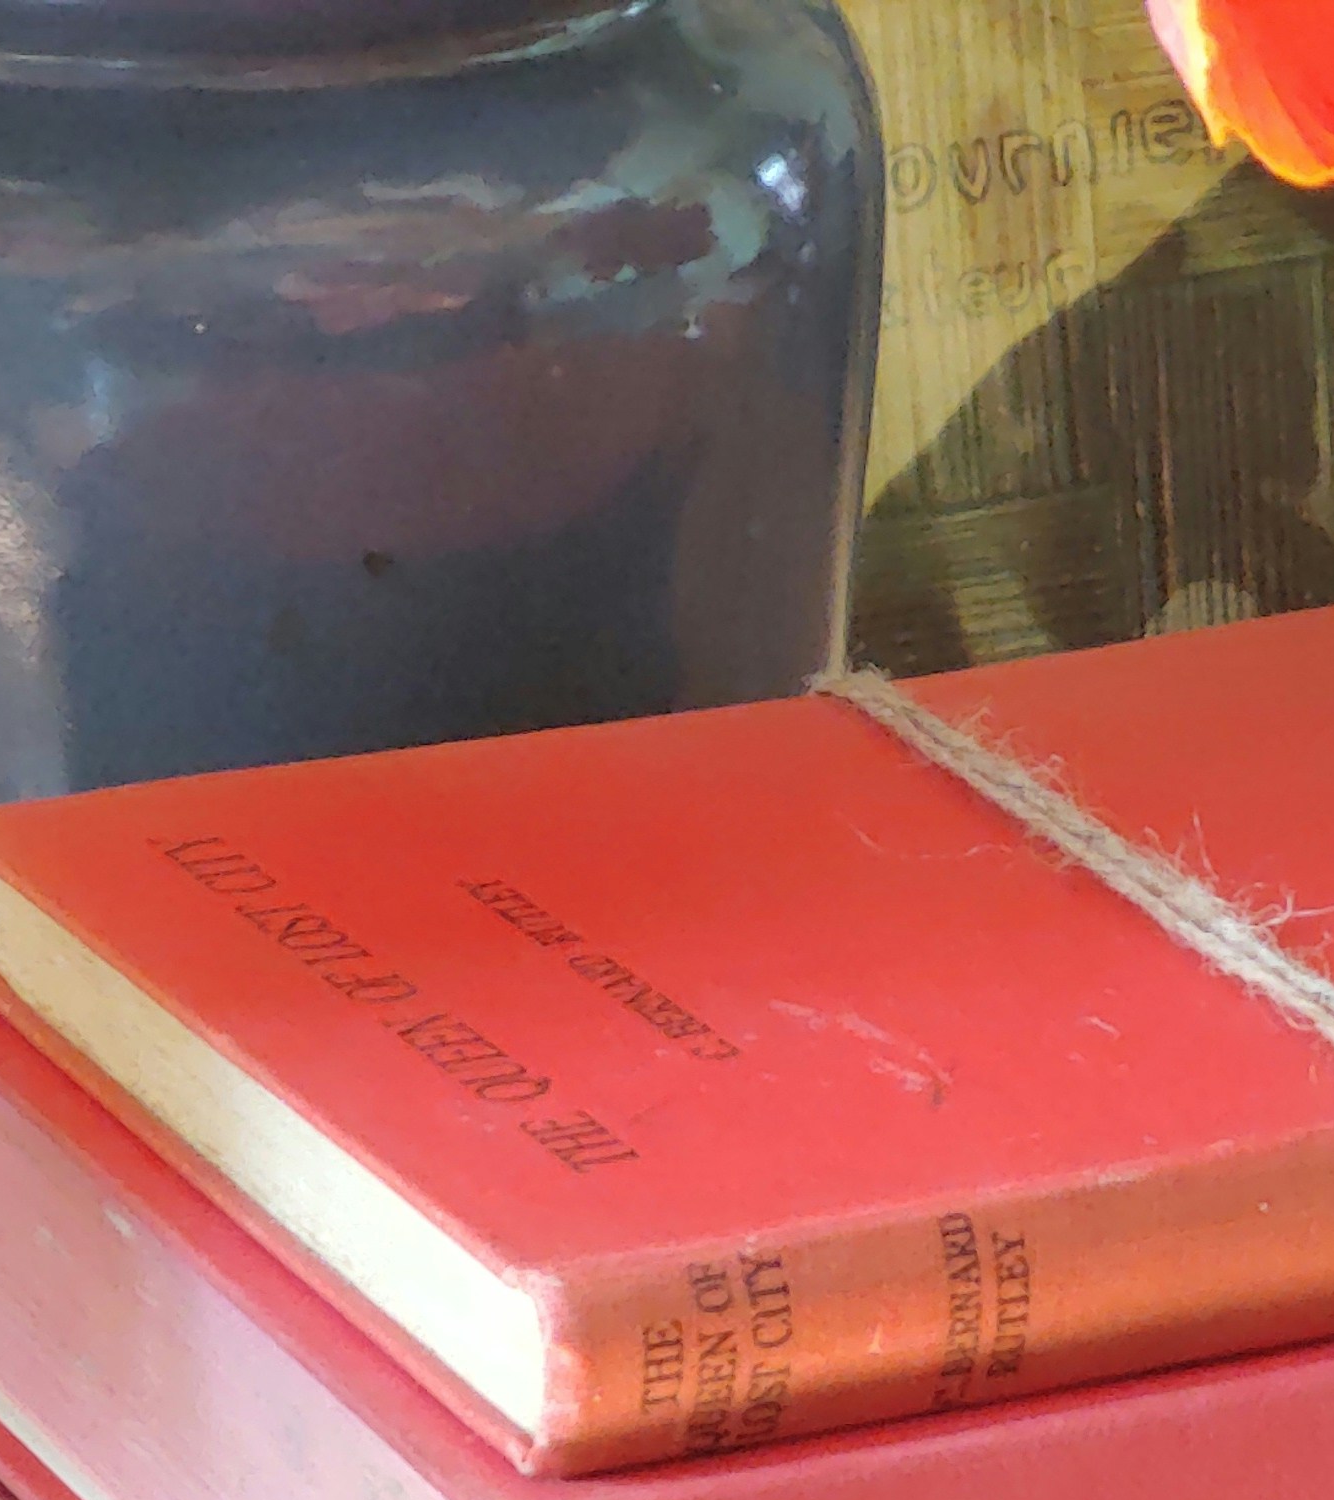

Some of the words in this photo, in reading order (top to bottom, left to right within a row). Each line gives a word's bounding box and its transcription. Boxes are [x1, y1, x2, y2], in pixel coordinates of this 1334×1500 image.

[148, 837, 277, 895] CITY
[235, 902, 373, 966] LOST
[326, 972, 416, 1007] OF
[382, 1012, 553, 1103] QUEEN
[520, 1110, 639, 1174] THE
[687, 1261, 735, 1314] OF
[739, 1251, 794, 1349] CITY
[939, 1211, 983, 1384] BERNARD
[986, 1230, 1031, 1381] RUTLEY
[641, 1319, 685, 1416] THE
[687, 1329, 739, 1450] QUEEN
